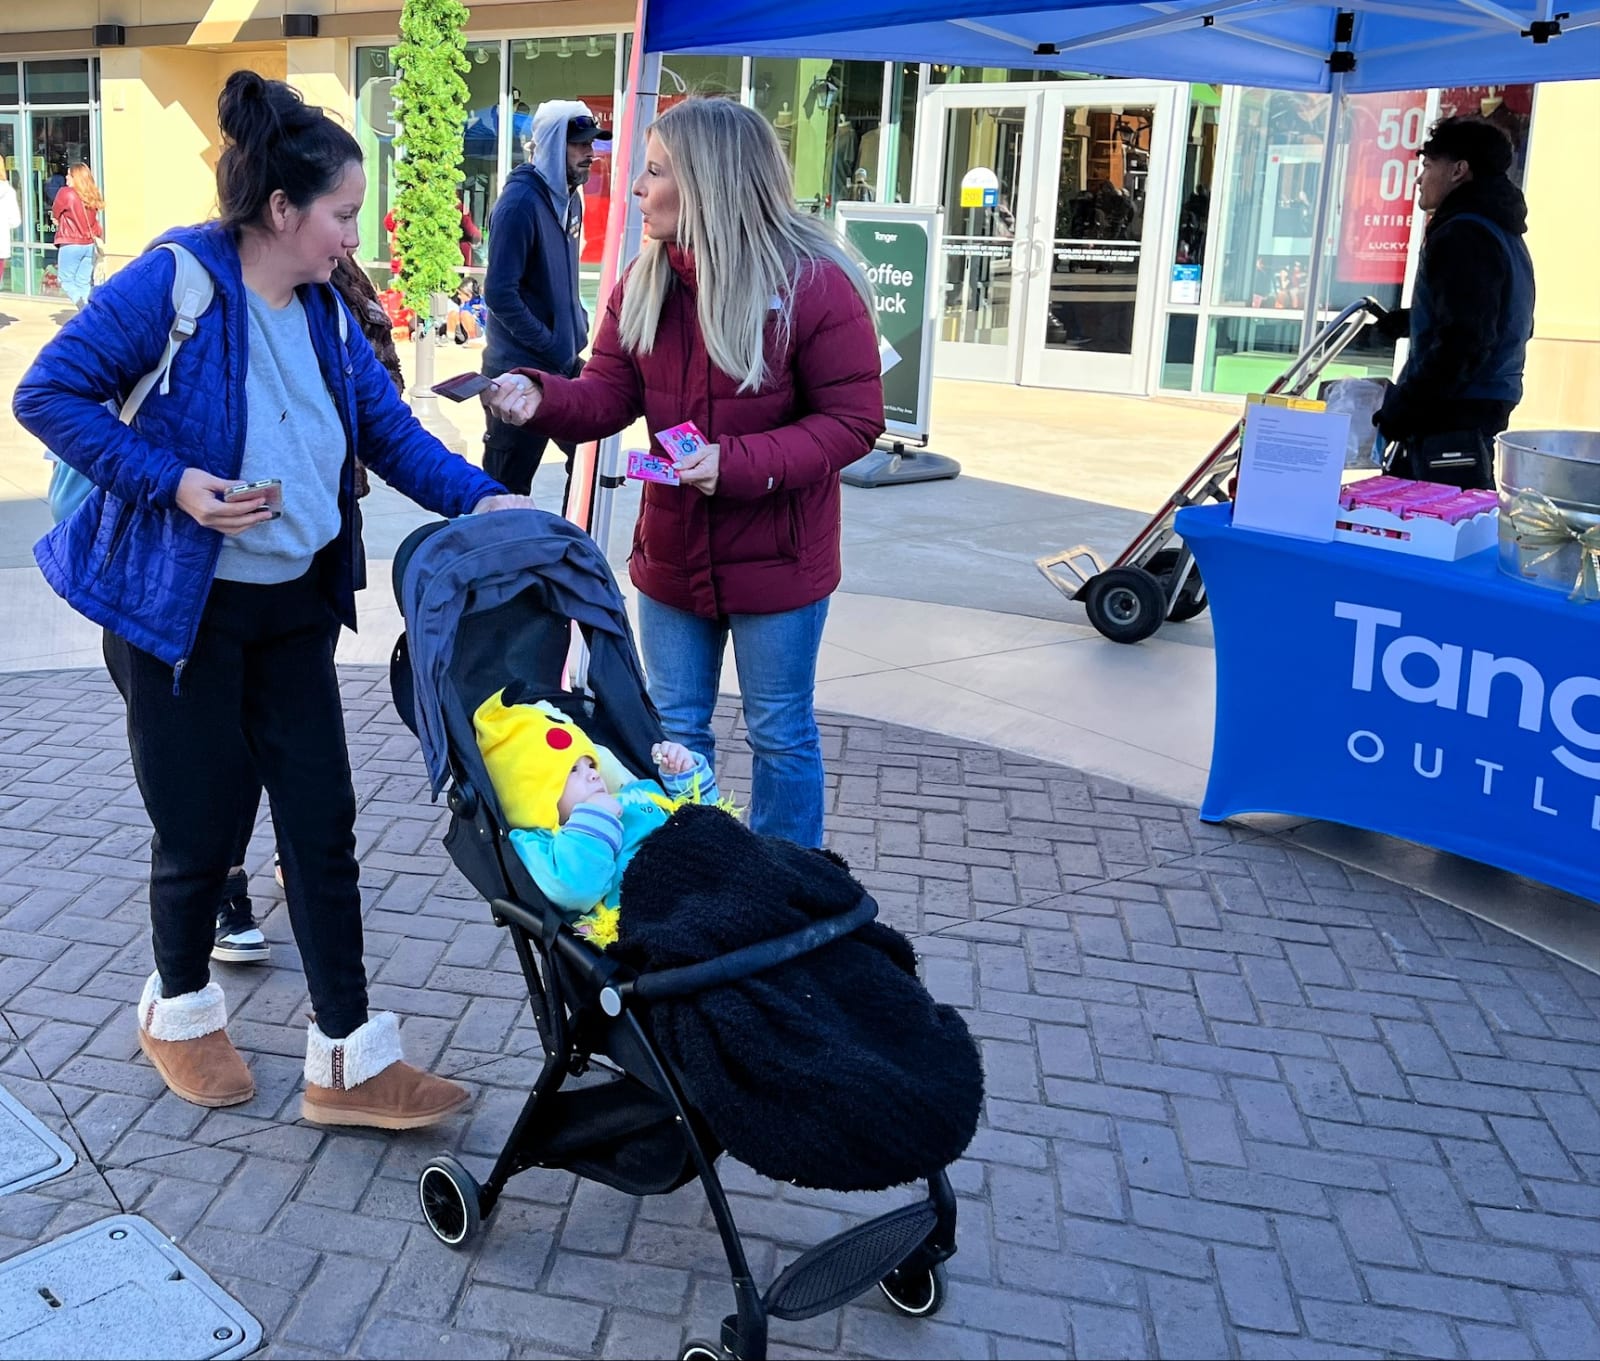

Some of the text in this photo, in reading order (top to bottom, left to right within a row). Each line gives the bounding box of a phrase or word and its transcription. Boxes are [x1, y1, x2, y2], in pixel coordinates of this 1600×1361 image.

[1380, 159, 1419, 201] OF
[1364, 214, 1413, 227] ENTIRE
[874, 231, 898, 243] Tanger
[1368, 242, 1405, 250] LUCKY
[873, 292, 906, 314] uck
[1334, 601, 1600, 781] Tang
